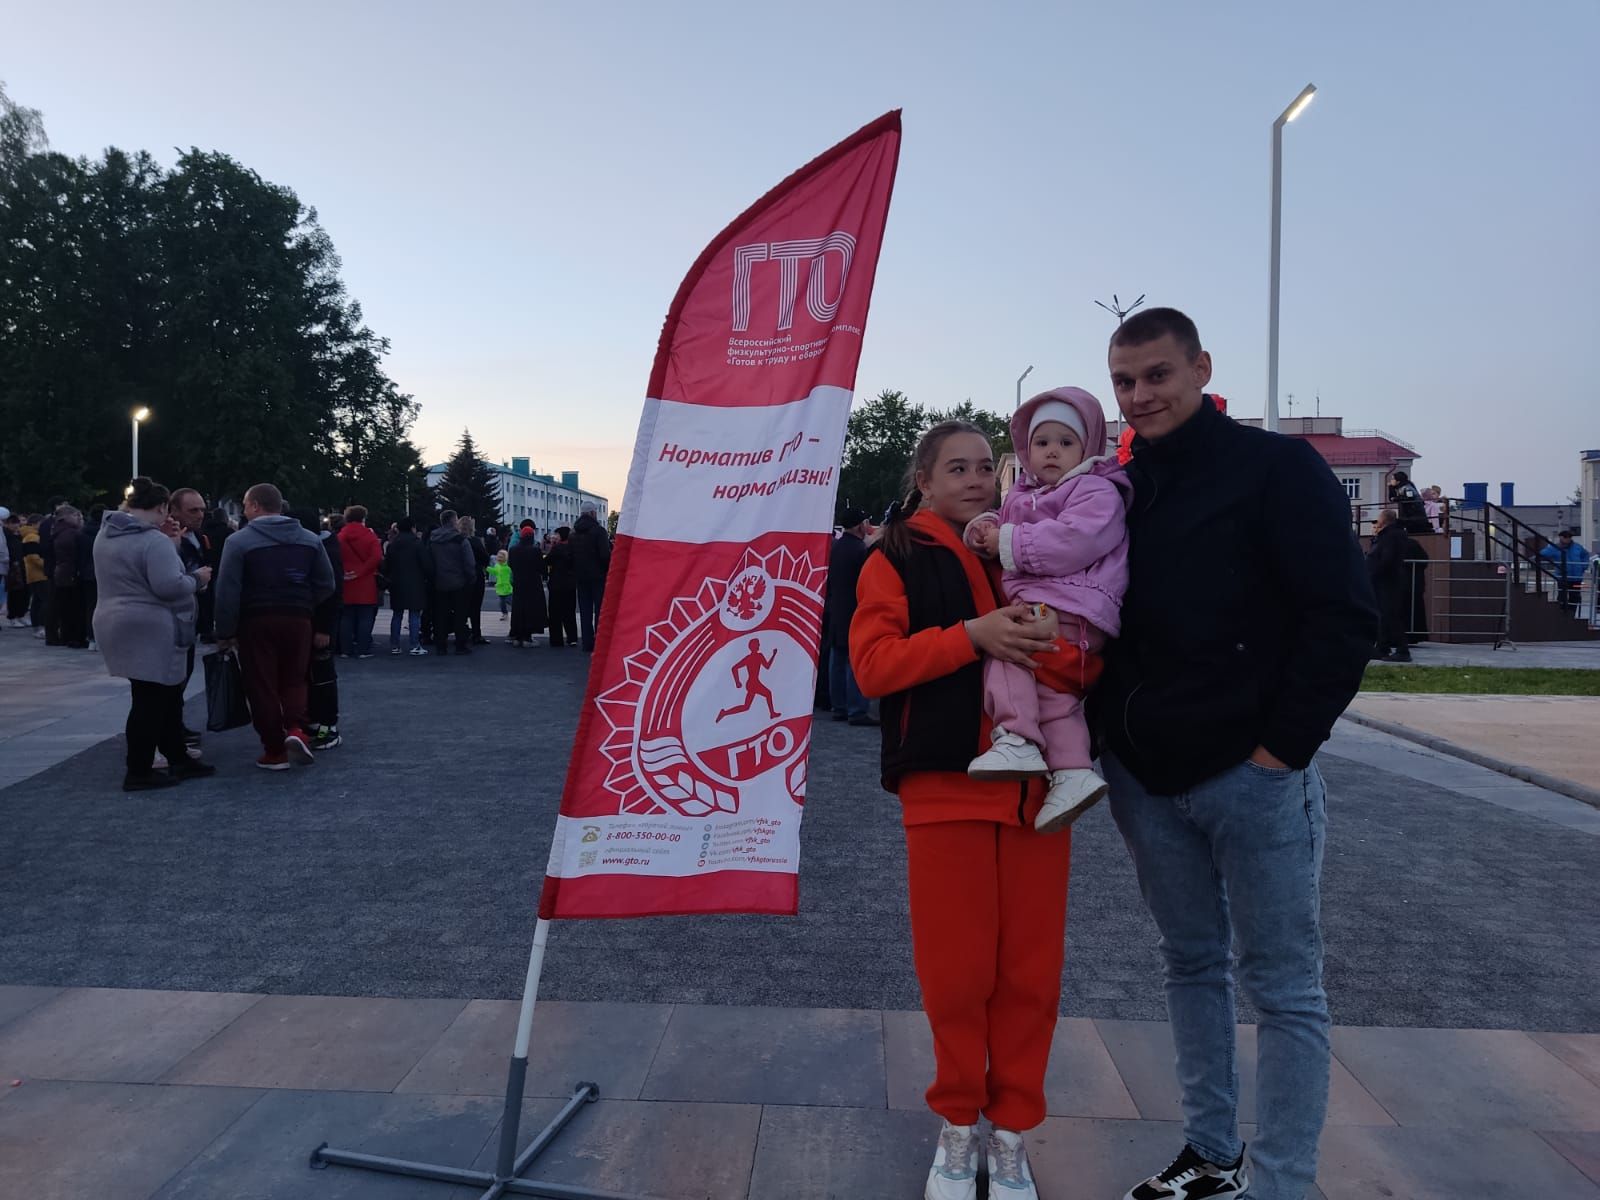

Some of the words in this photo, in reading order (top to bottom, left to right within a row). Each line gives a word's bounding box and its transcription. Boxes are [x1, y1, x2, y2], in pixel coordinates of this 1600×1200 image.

[732, 231, 856, 331] ГТО
[831, 324, 861, 336] омплекс
[728, 334, 792, 347] Всероссийский
[765, 356, 789, 365] труду
[658, 442, 774, 468] Норматив
[713, 480, 777, 503] норма
[776, 466, 833, 491] жизни!
[728, 725, 794, 779] ГТО
[602, 857, 650, 866] www.gto.ru
